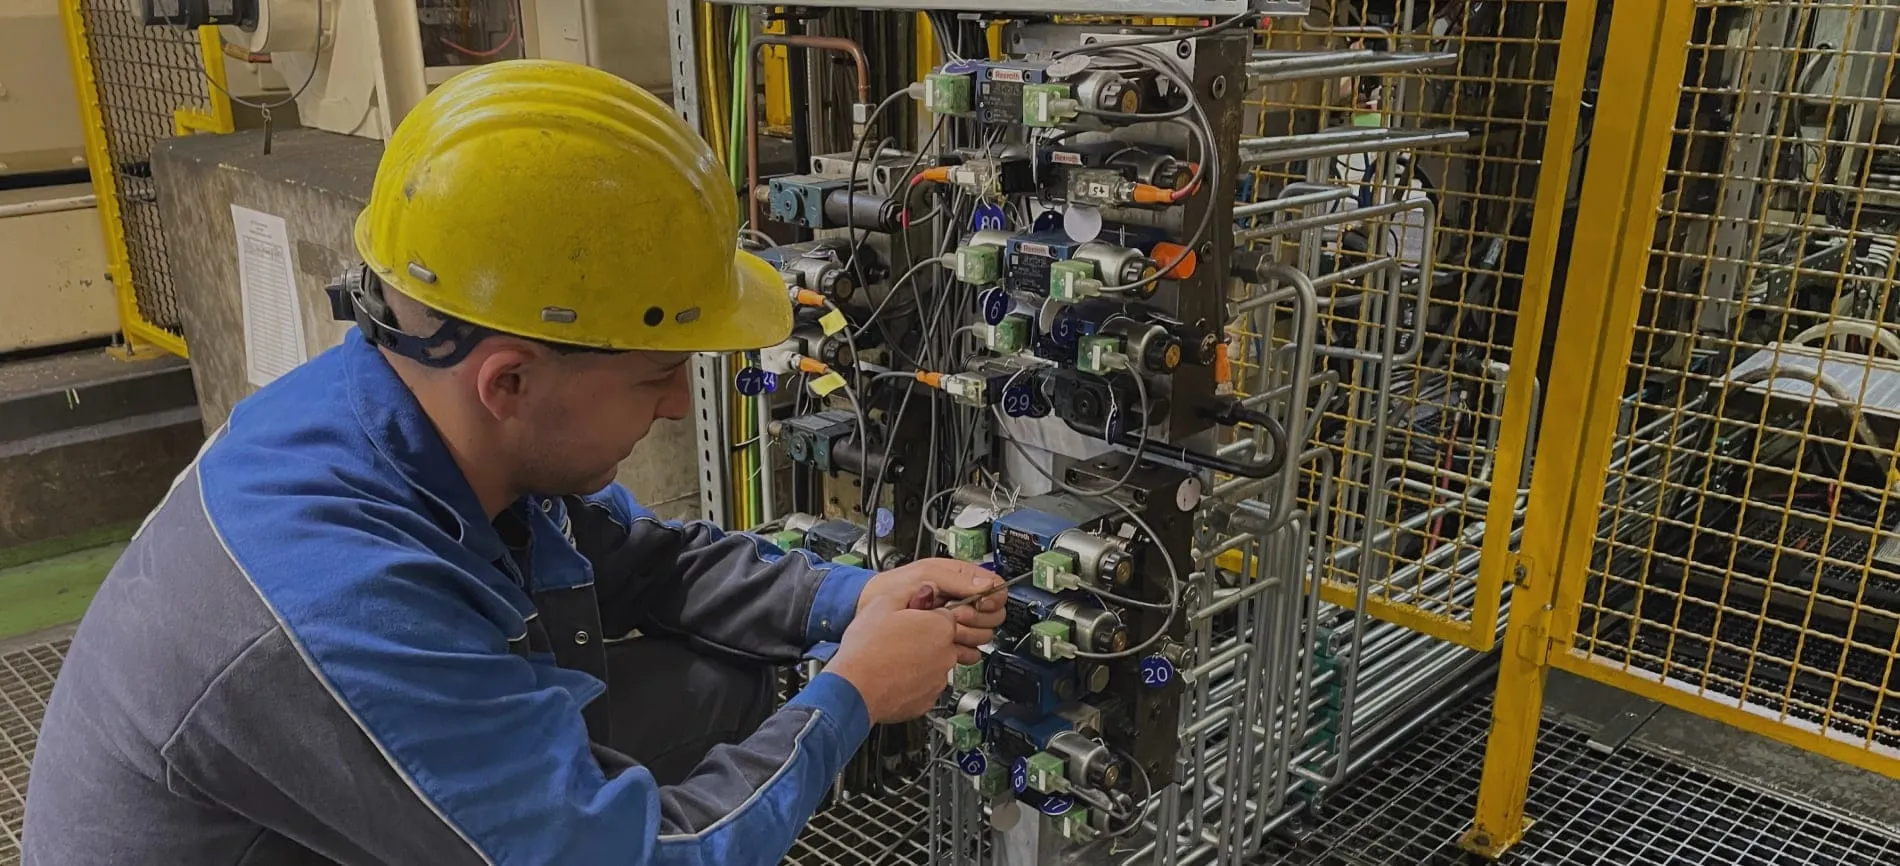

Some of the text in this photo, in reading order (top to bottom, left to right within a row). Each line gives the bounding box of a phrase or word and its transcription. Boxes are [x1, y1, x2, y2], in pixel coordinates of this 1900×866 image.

[991, 300, 1001, 319] 6
[741, 377, 761, 393] 71
[1007, 394, 1030, 413] 29
[1144, 666, 1168, 684] 20
[1013, 764, 1024, 789] 15
